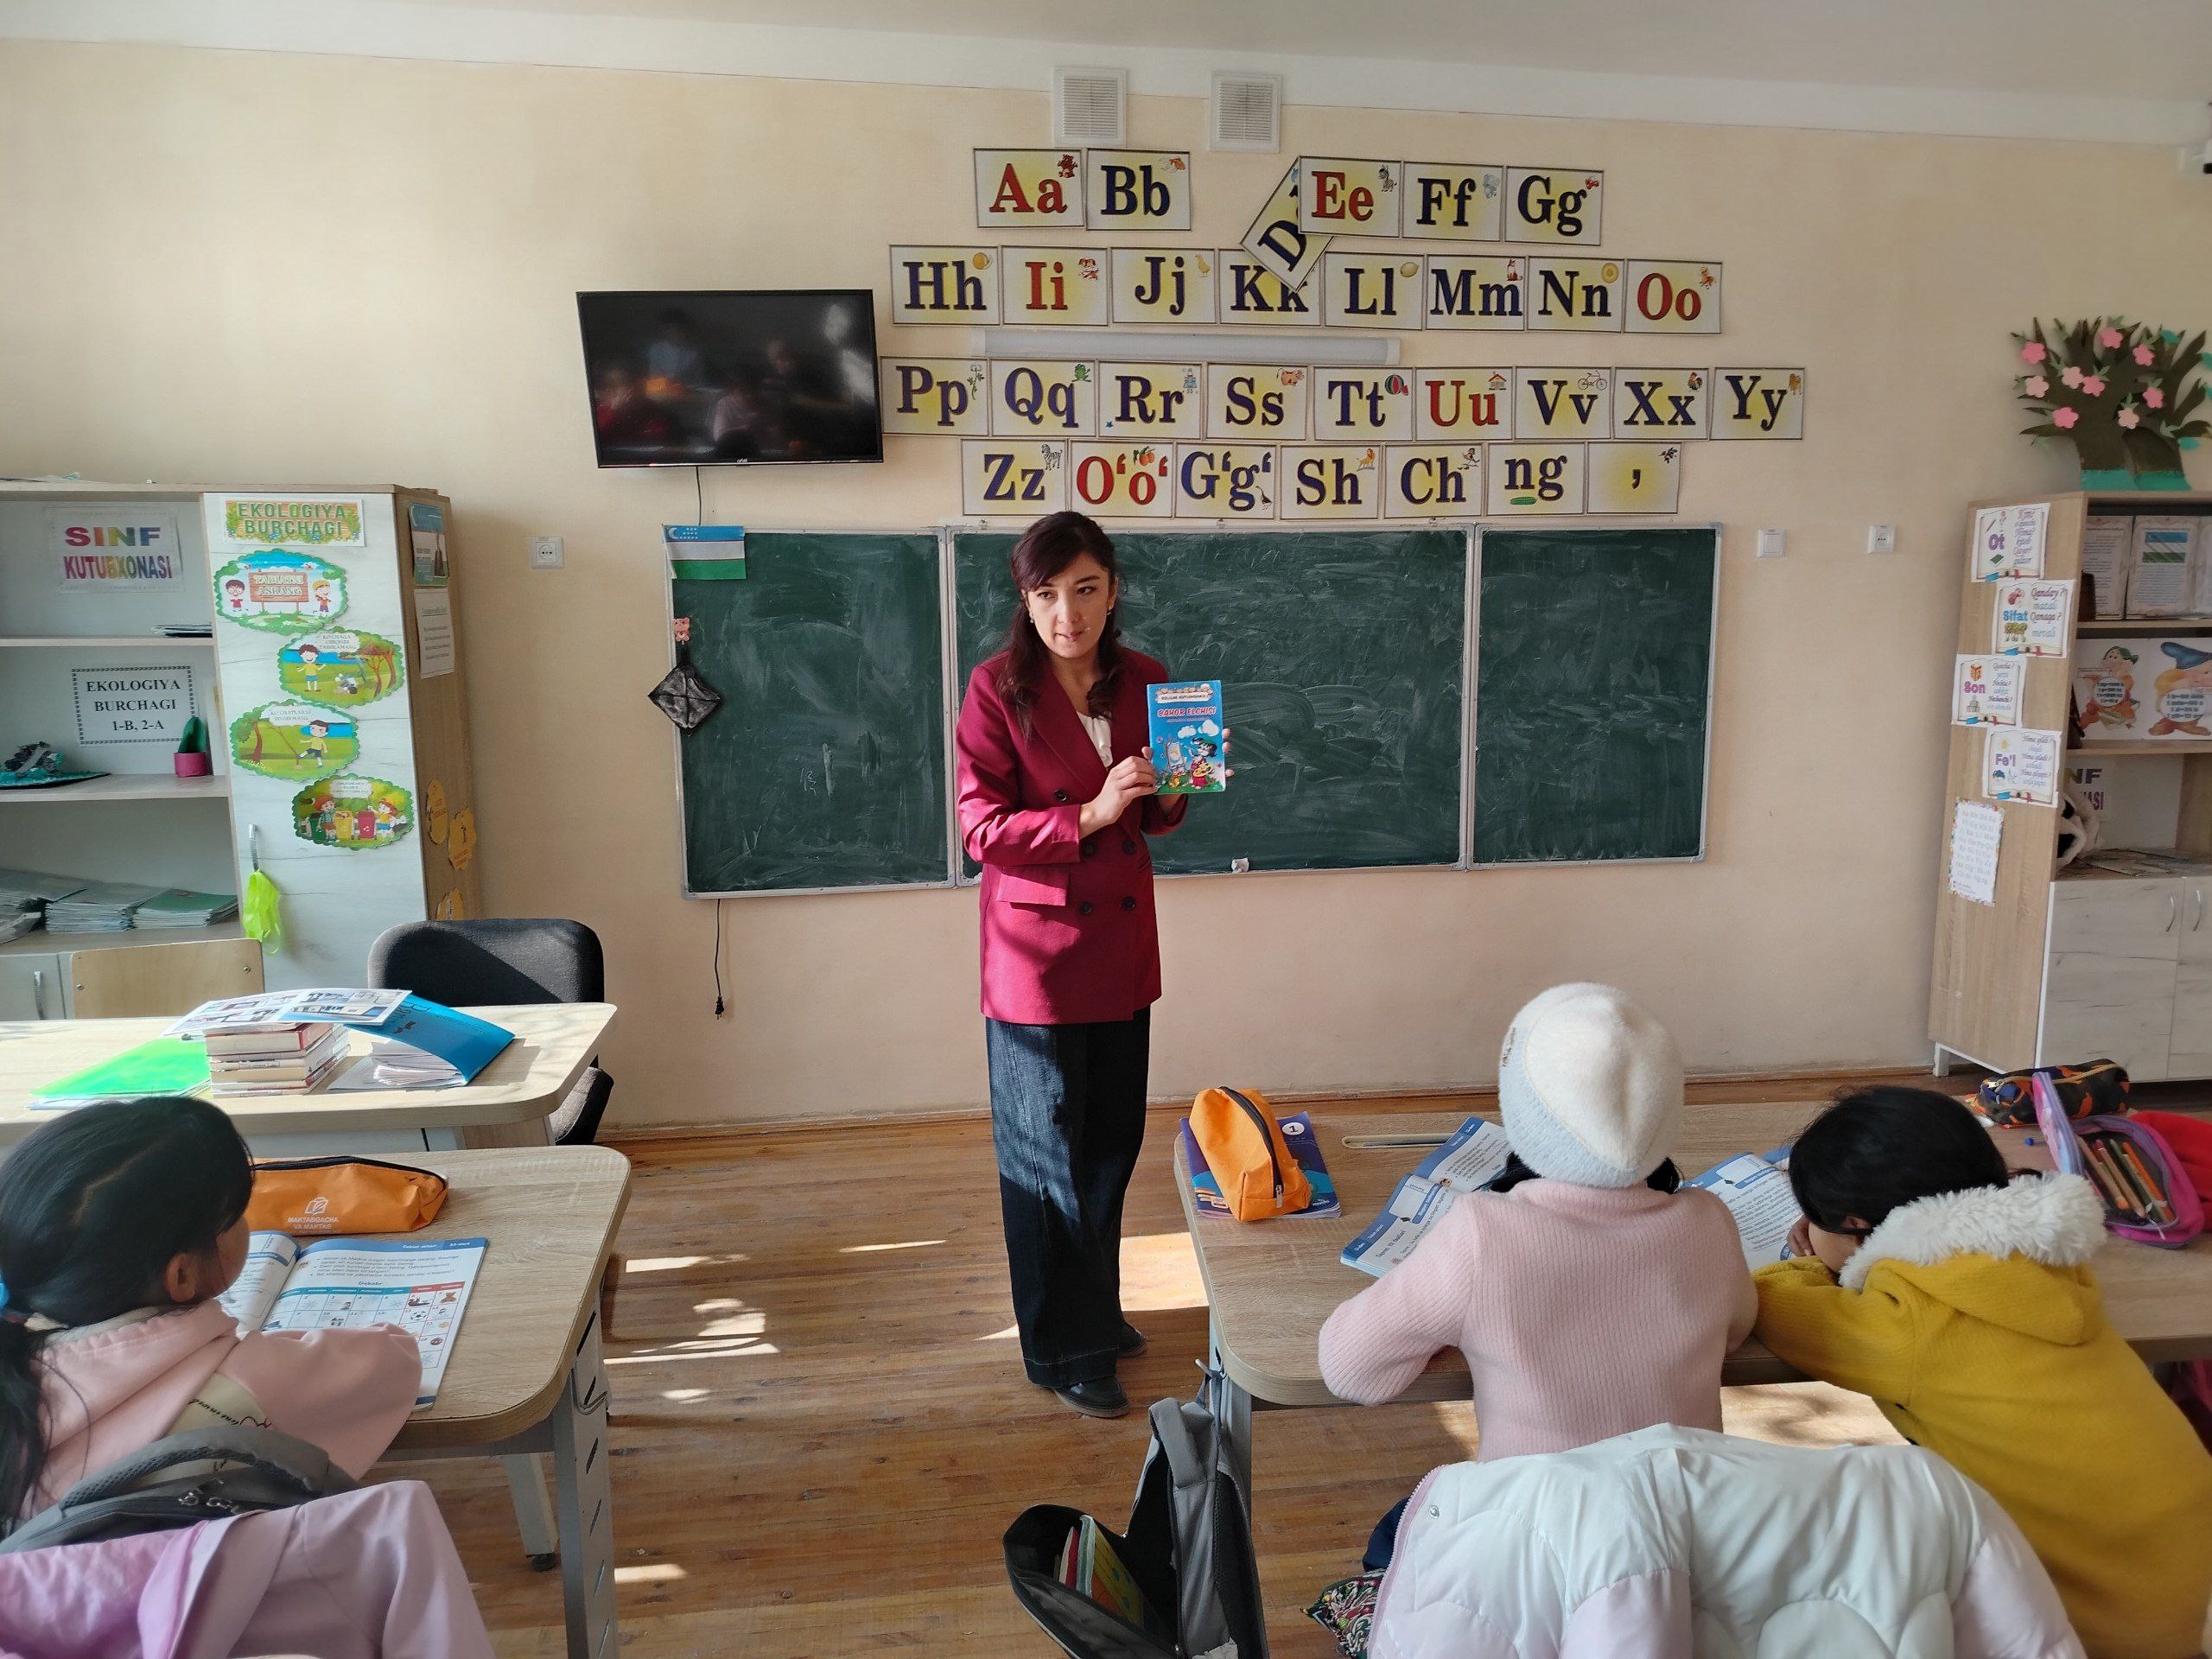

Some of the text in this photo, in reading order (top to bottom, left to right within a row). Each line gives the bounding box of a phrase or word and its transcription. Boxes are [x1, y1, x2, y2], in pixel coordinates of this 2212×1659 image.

[988, 162, 1068, 214] Aa
[1100, 163, 1171, 217] Bb
[1311, 169, 1375, 221] Ee
[1416, 176, 1476, 226] Ff
[1517, 175, 1587, 237] Gg
[903, 259, 988, 311] Hh
[1025, 260, 1069, 311] Ii
[1134, 256, 1185, 317] Jj
[1344, 265, 1397, 315] Ll
[1430, 267, 1523, 317] Mm
[1537, 269, 1611, 318] Nn
[1637, 271, 1702, 321] Oo
[895, 365, 1788, 431] Pp Qq Rr Ss Tt Uu Vv Xx Yy
[982, 454, 1046, 501] Zz
[1296, 458, 1363, 505] Sh
[1400, 455, 1467, 505] Ch
[1503, 454, 1569, 502] ng
[238, 503, 346, 518] EKOLOGIYA
[244, 519, 343, 535] BURCHAGI
[65, 526, 162, 547] SINF
[1988, 533, 2005, 550] Ot
[63, 556, 174, 579] KUTUBXONASI
[256, 586, 302, 596] ASRANG
[2003, 609, 2028, 622] Sifat
[86, 679, 181, 692] EKOLOGIYA
[1964, 680, 1986, 694] Son
[94, 699, 176, 711] BURCHAGI
[112, 720, 164, 732] 1-B, 2-A
